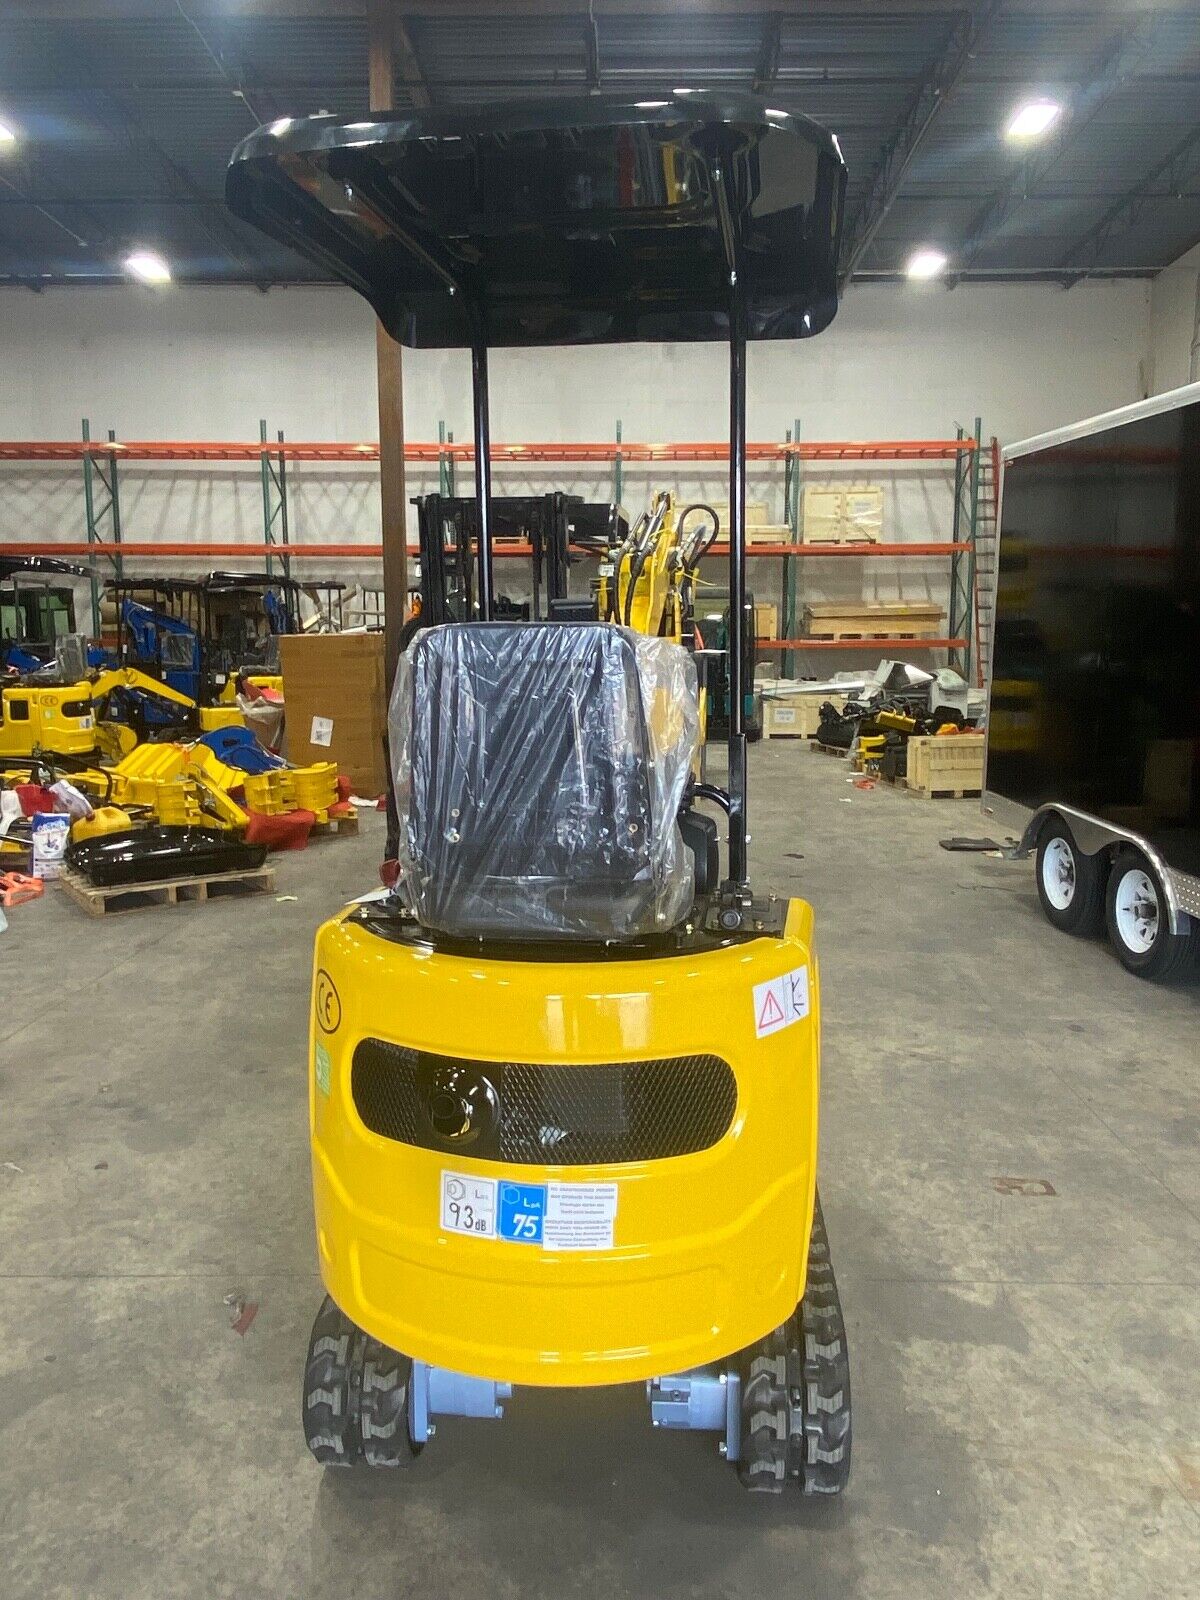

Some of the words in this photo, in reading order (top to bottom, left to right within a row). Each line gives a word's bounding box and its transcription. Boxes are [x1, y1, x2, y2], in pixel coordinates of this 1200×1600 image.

[449, 1202, 474, 1229] 93
[474, 1219, 487, 1232] dB
[512, 1213, 539, 1238] 75
